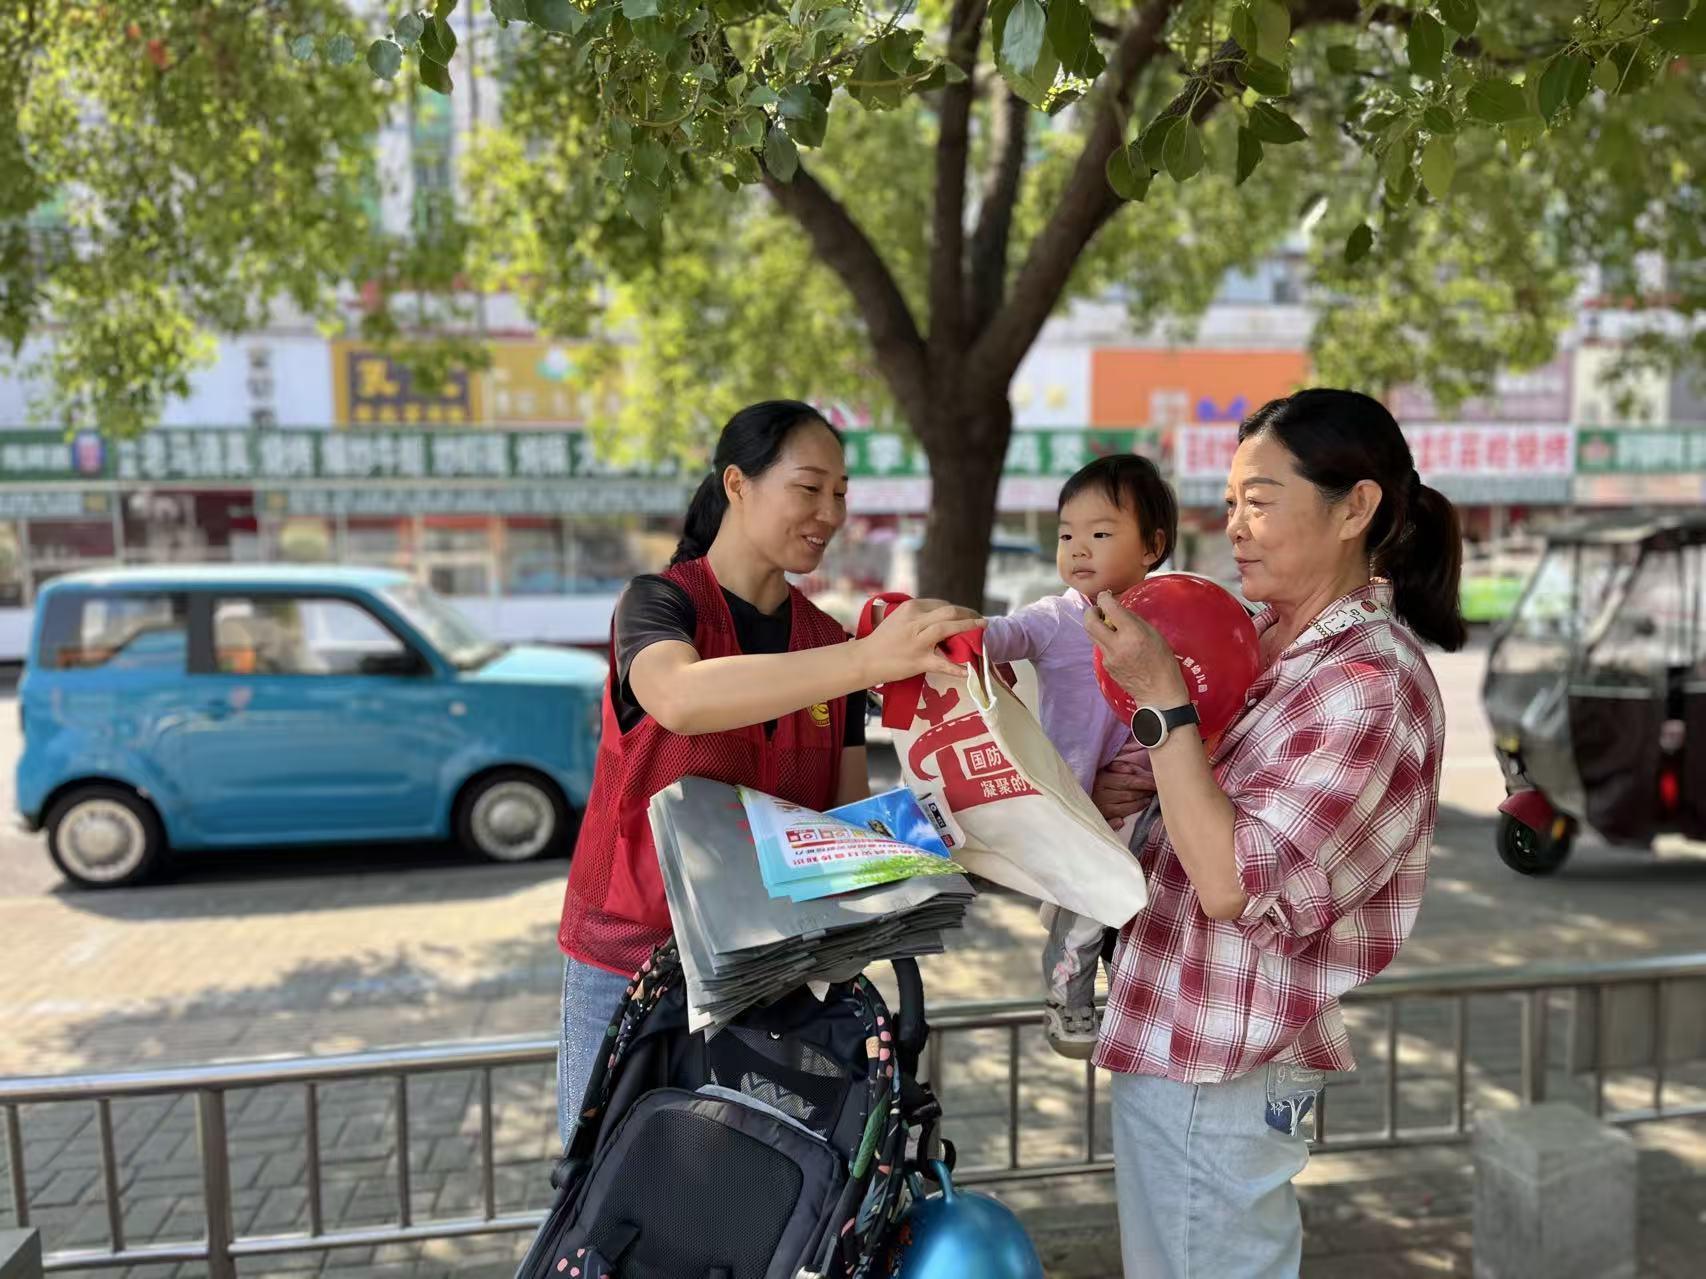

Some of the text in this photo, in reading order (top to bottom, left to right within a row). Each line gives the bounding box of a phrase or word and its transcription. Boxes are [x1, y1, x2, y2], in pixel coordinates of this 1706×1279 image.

[970, 745, 1002, 771] 国防
[981, 774, 1033, 798] 凝聚的
